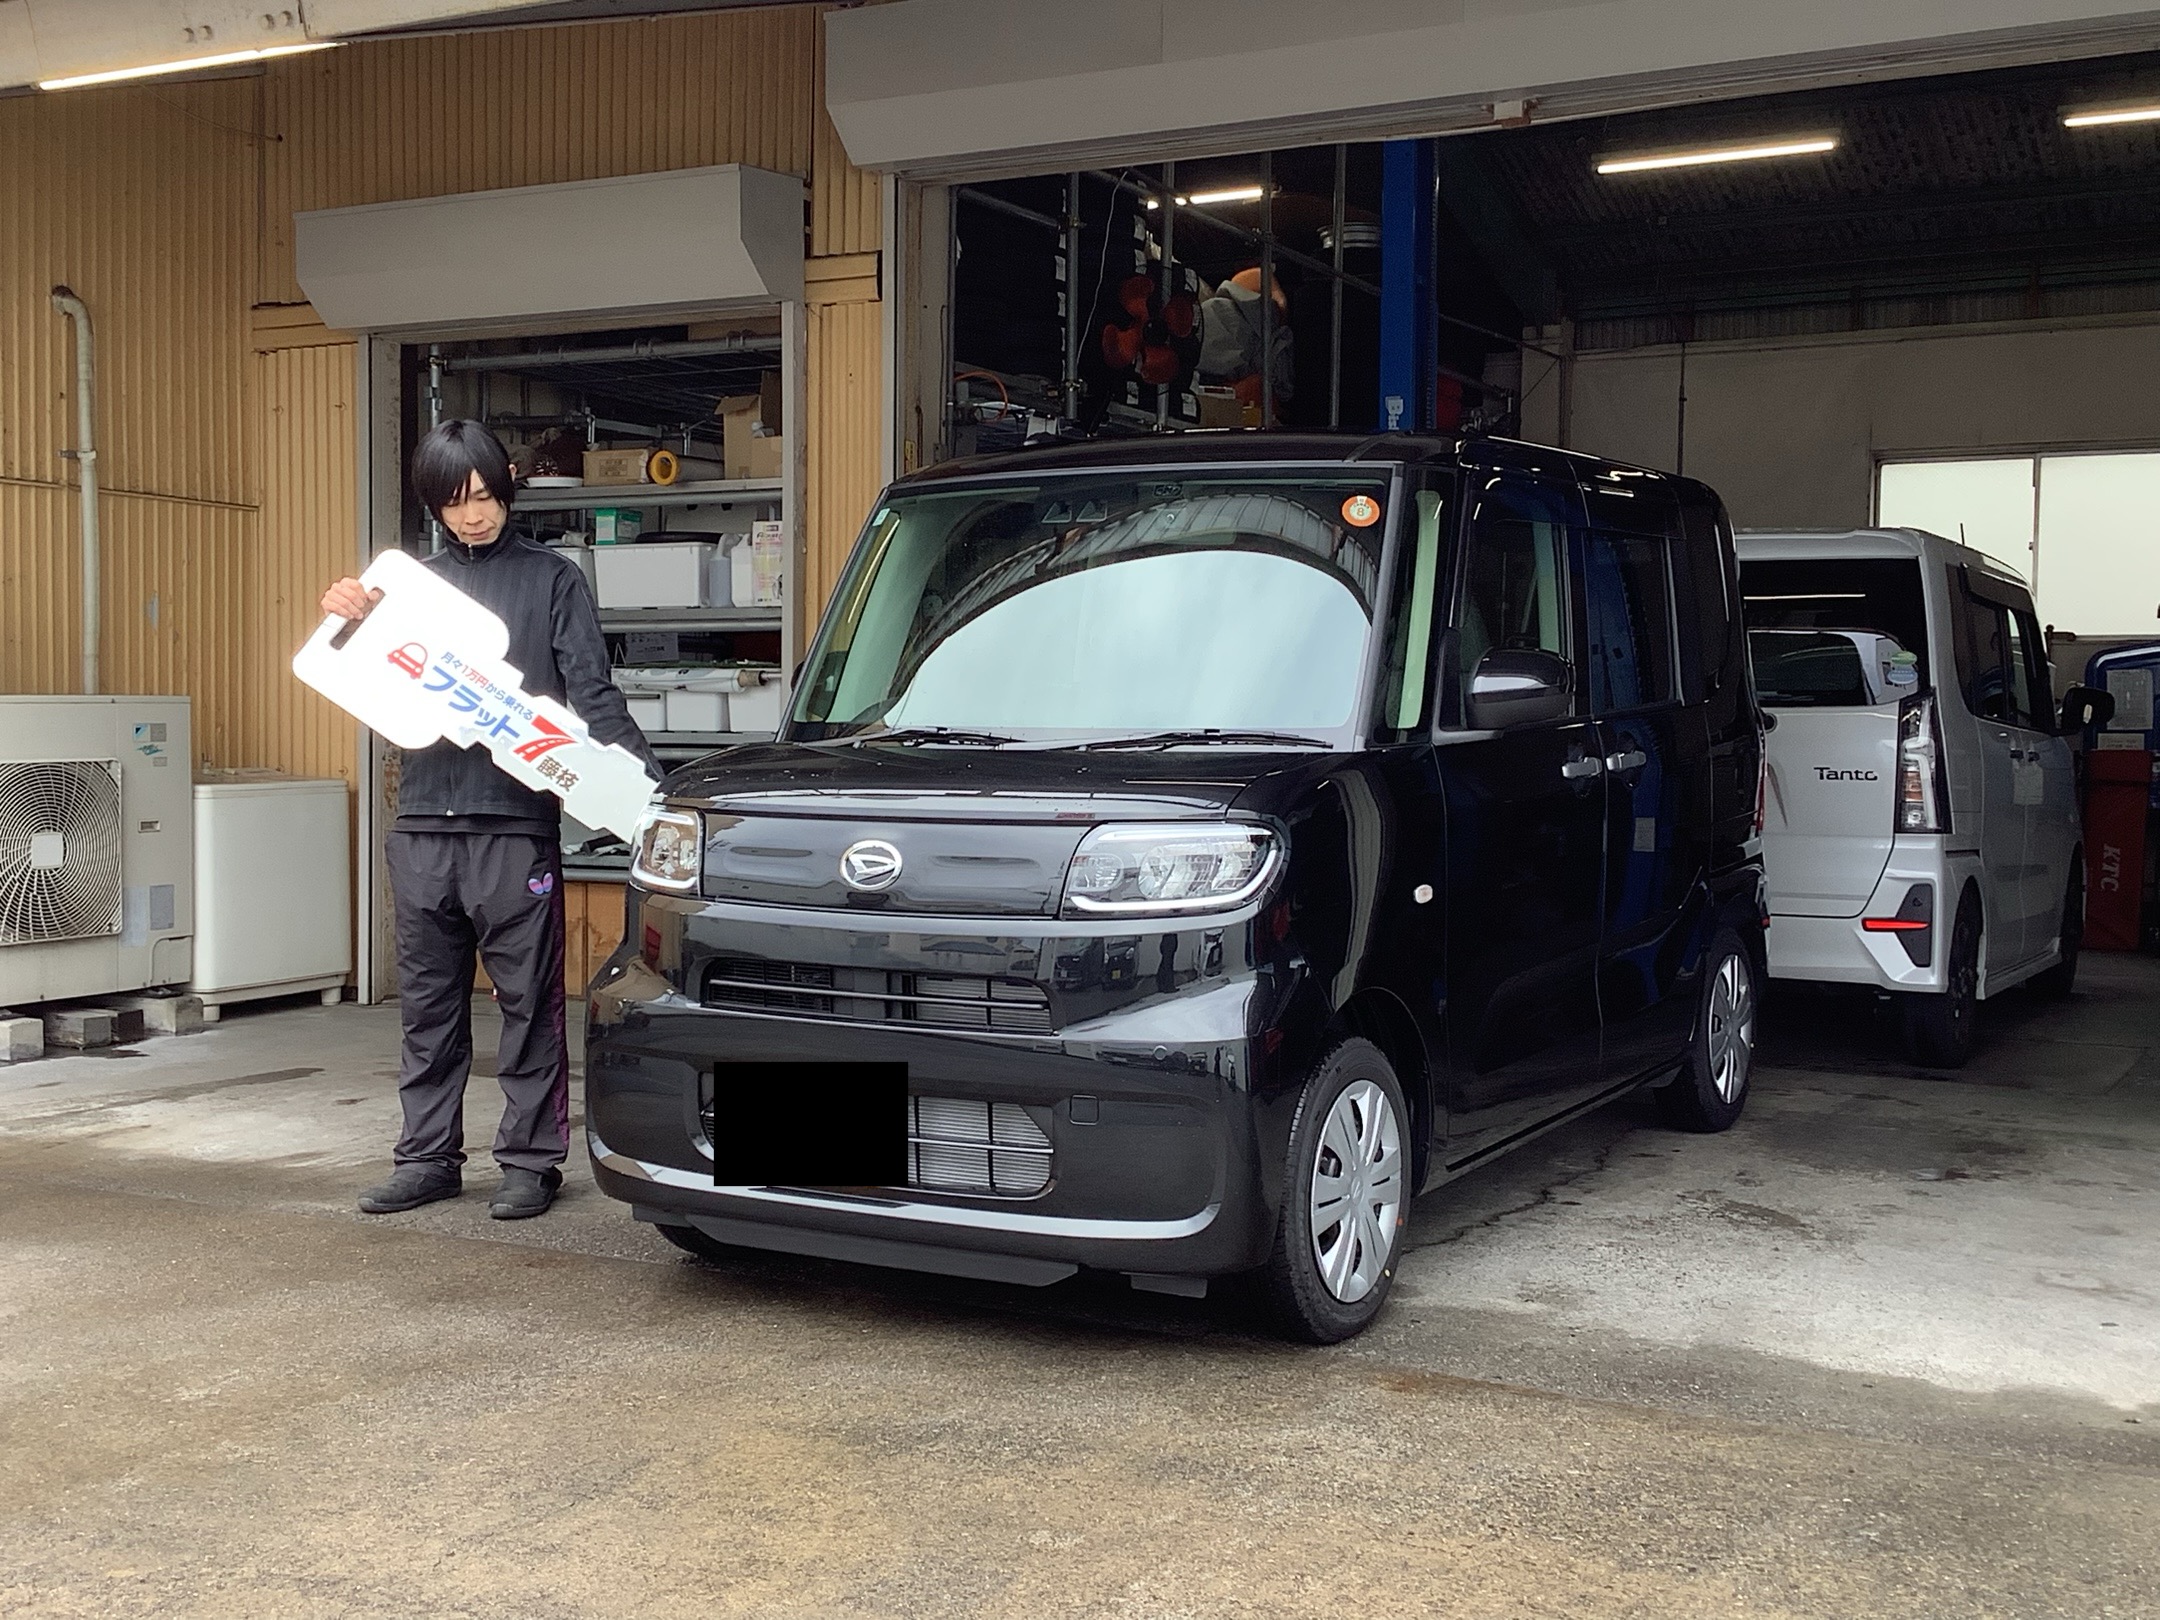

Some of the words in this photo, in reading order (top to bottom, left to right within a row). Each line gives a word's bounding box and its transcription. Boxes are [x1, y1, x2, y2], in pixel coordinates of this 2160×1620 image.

[441, 652, 534, 721] 月々1万円から乗れる
[536, 755, 579, 792] 藤枝
[1813, 767, 1878, 781] Tanto
[2101, 844, 2121, 892] KTC
